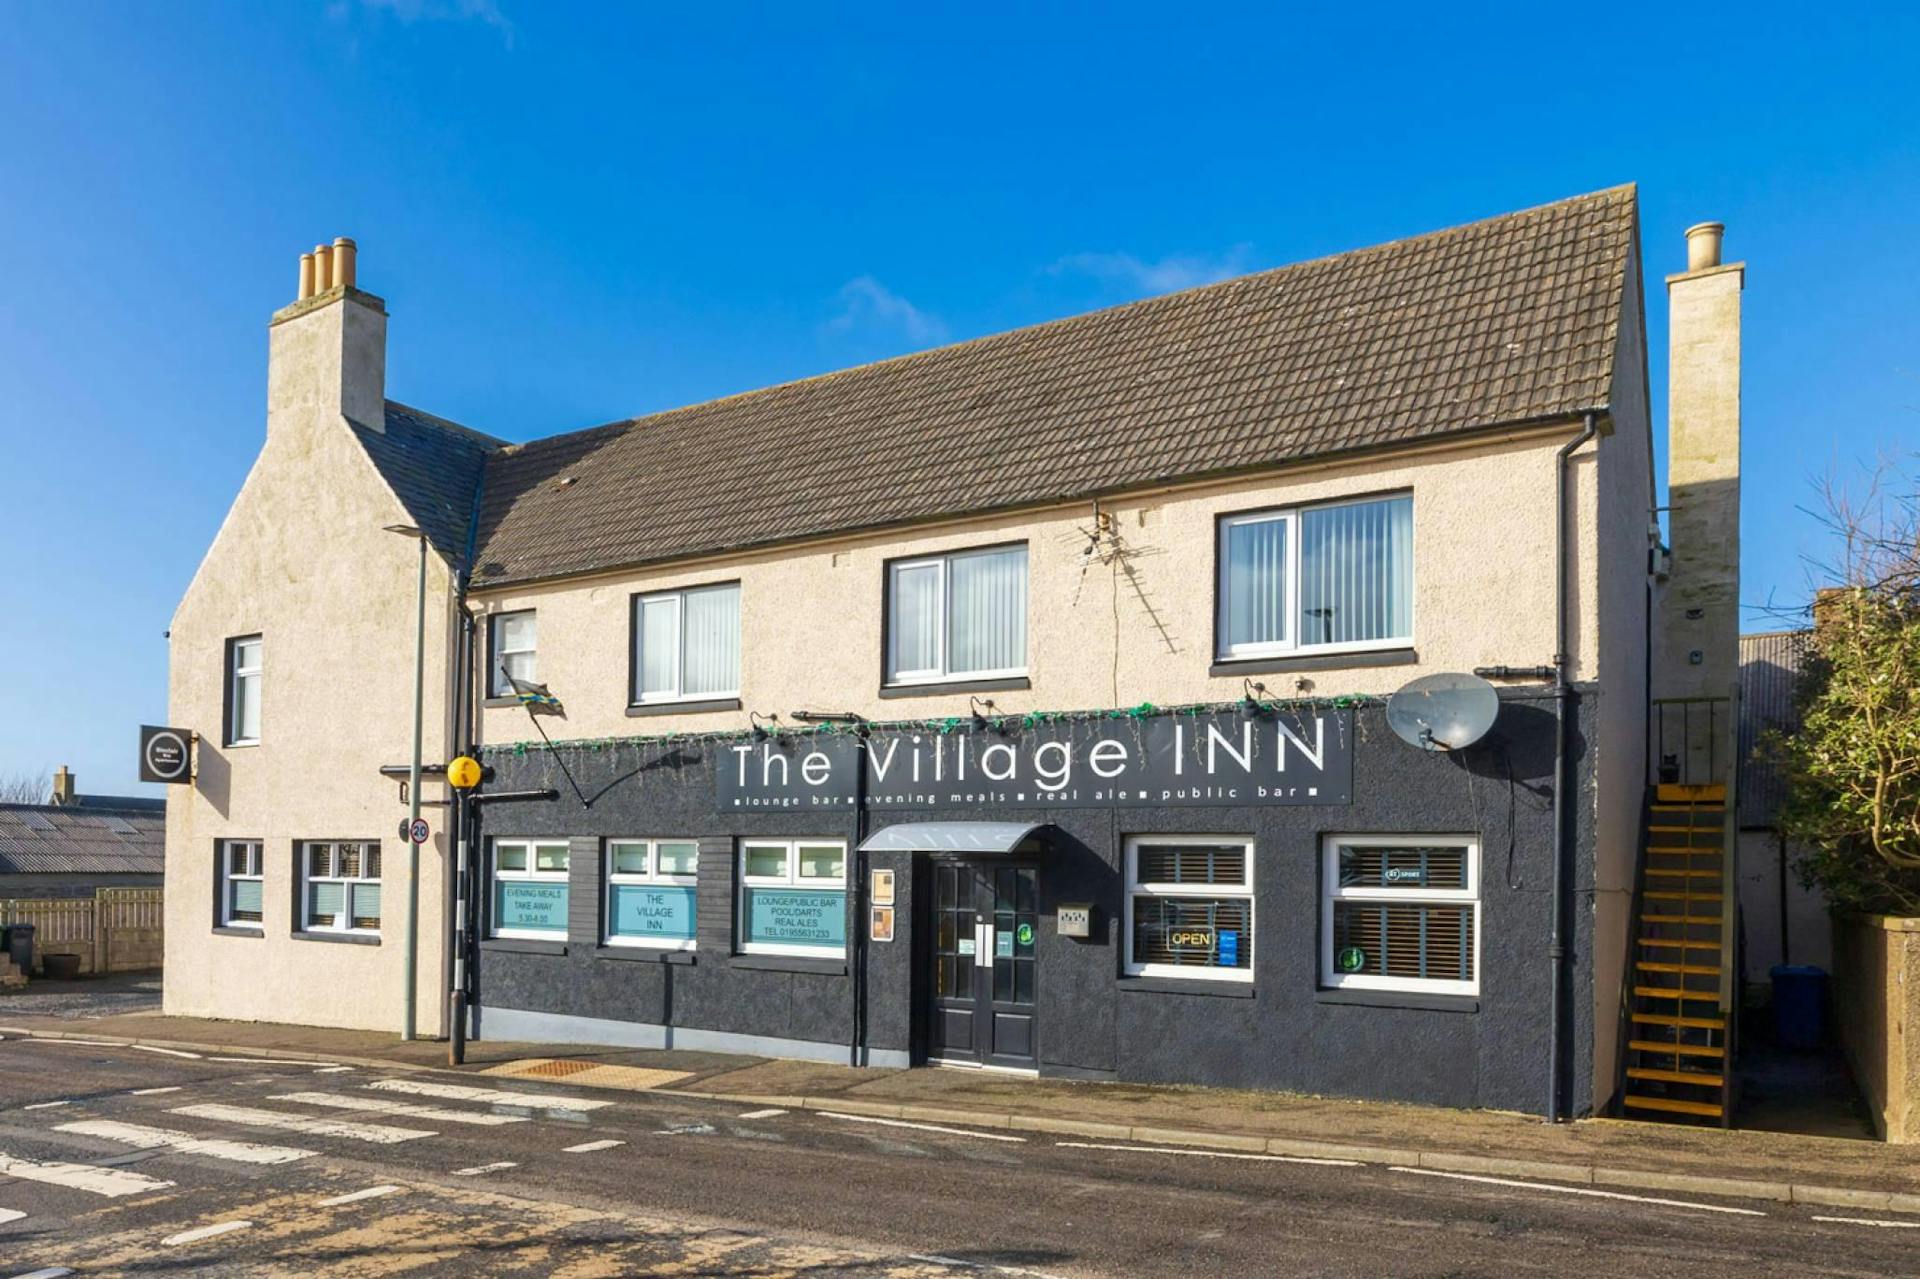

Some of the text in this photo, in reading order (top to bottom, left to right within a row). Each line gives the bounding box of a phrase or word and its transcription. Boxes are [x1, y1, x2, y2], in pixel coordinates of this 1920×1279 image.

[733, 717, 1324, 791] The Village INN
[746, 796, 799, 808] lounge
[812, 795, 839, 805] bar
[951, 791, 1006, 803] meals
[1036, 789, 1077, 801] real
[1095, 788, 1127, 799] ale
[1162, 786, 1238, 800] public
[1258, 785, 1296, 797] bar
[413, 825, 427, 837] 20
[506, 888, 561, 899] EVENING MEALS
[646, 894, 664, 904] THE
[514, 901, 554, 911] TAKE AWAY
[637, 907, 674, 918] VILLAGE
[646, 920, 663, 930] INN
[775, 917, 818, 927] REAL ALES
[764, 927, 779, 936] TEL
[1171, 932, 1210, 945] OPEN
